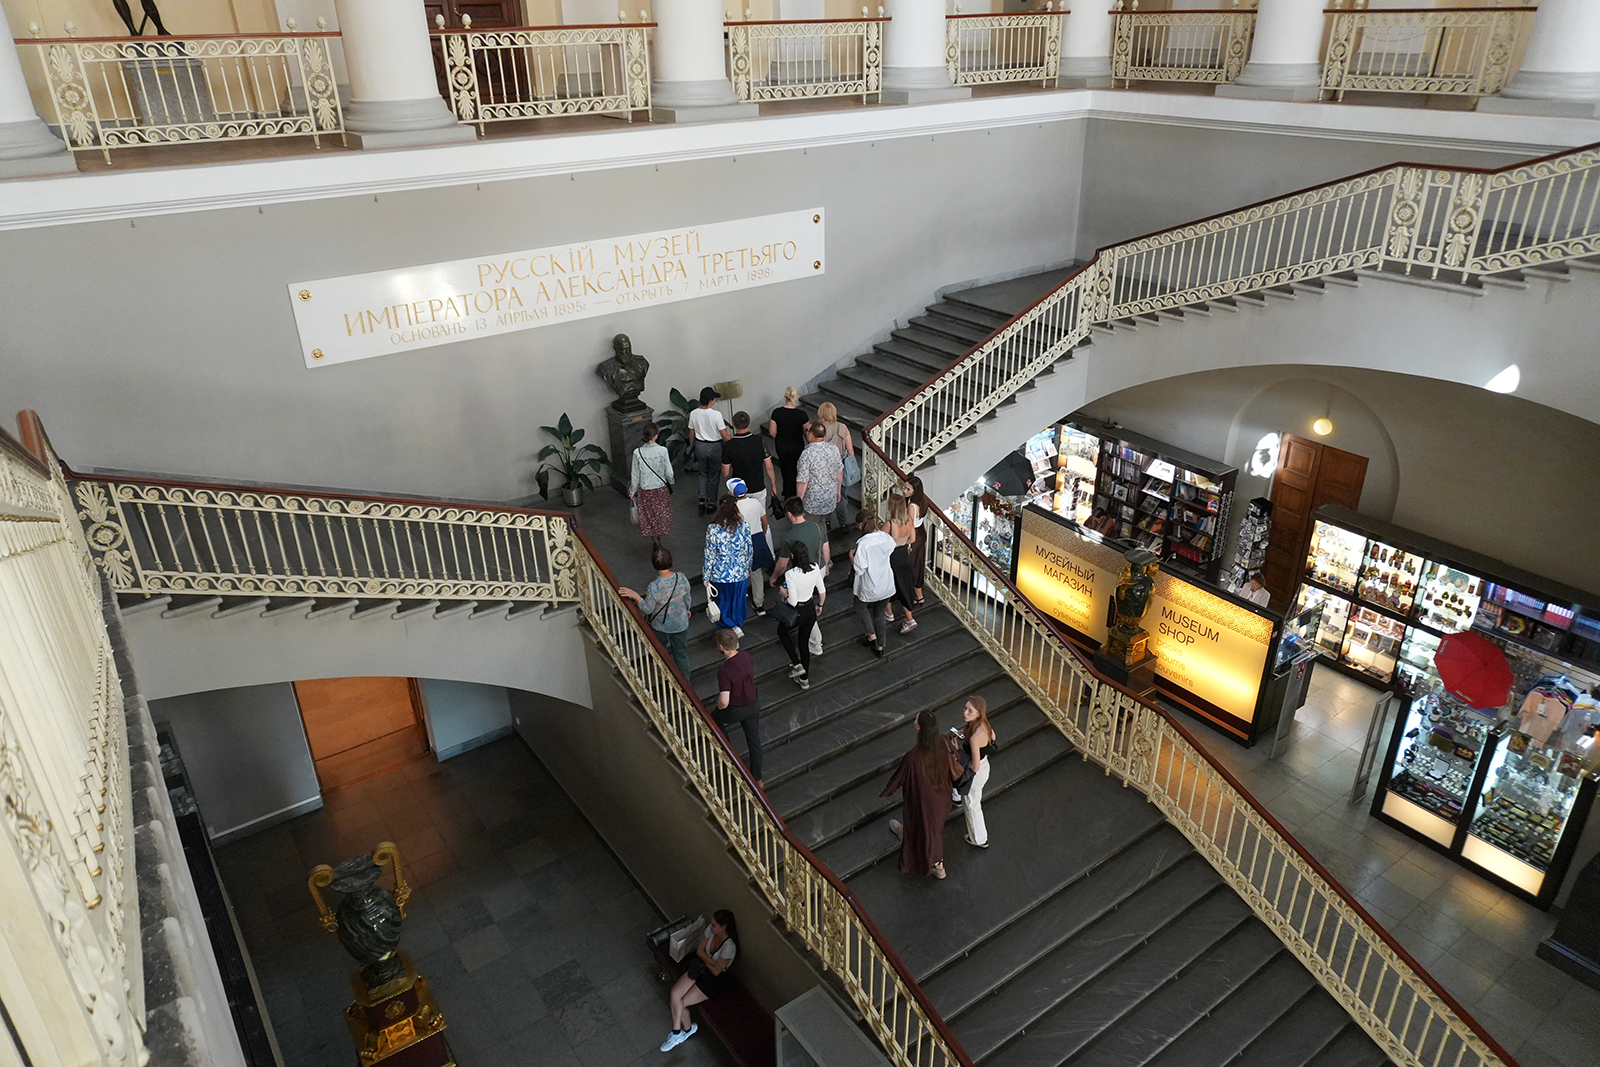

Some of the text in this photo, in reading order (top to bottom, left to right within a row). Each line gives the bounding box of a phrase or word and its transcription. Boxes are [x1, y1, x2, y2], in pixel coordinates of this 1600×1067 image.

[478, 229, 700, 287] РУССКІЙ МУЗЕЙ
[344, 240, 797, 337] ИМПЕРАТОРА АЛЕКСАНДРА ТРЕТЬЯГО
[390, 321, 467, 345] ОСНОВАНЪ
[475, 317, 488, 331] 13
[616, 285, 674, 305] ОТКРЫТЪ
[682, 281, 689, 293] 7
[699, 273, 739, 290] МАРТА
[1035, 545, 1095, 583] МУЗЕЙНЫЙ
[1043, 564, 1093, 598] МАГАЗИН
[1052, 608, 1089, 631] сувениры
[1056, 599, 1090, 620] альбомы
[1161, 606, 1220, 643] MUSEUM
[1156, 637, 1183, 657] books
[1158, 622, 1195, 646] SHOP
[1155, 650, 1186, 671] albums
